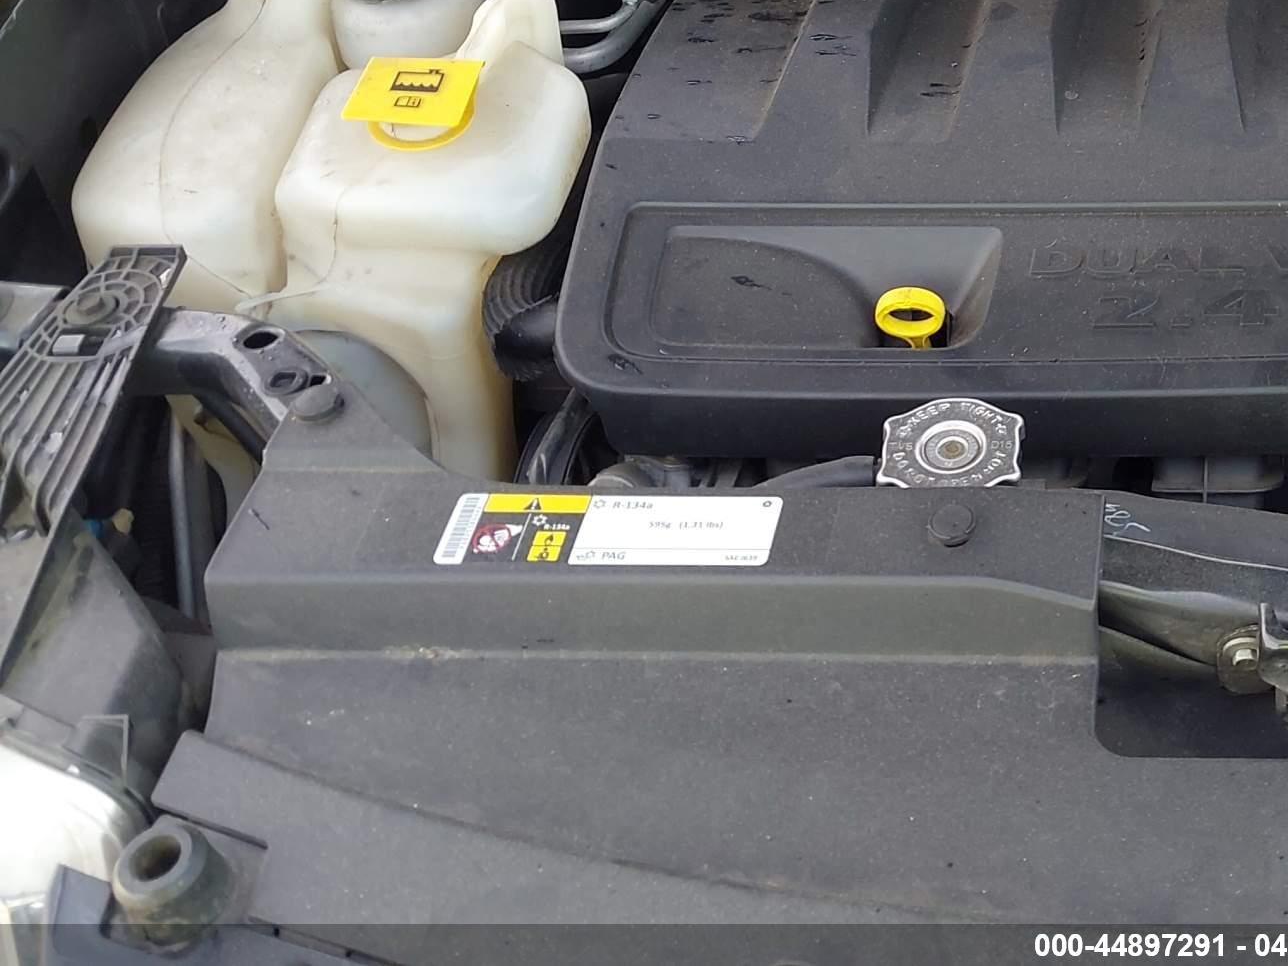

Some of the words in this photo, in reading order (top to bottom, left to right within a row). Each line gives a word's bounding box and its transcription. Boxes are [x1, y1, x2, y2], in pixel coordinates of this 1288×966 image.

[1028, 246, 1247, 278] DUAL
[908, 402, 951, 425] KEEP
[960, 402, 1004, 425] TIGHT
[612, 500, 654, 510] R-134a
[601, 551, 626, 561] PAG
